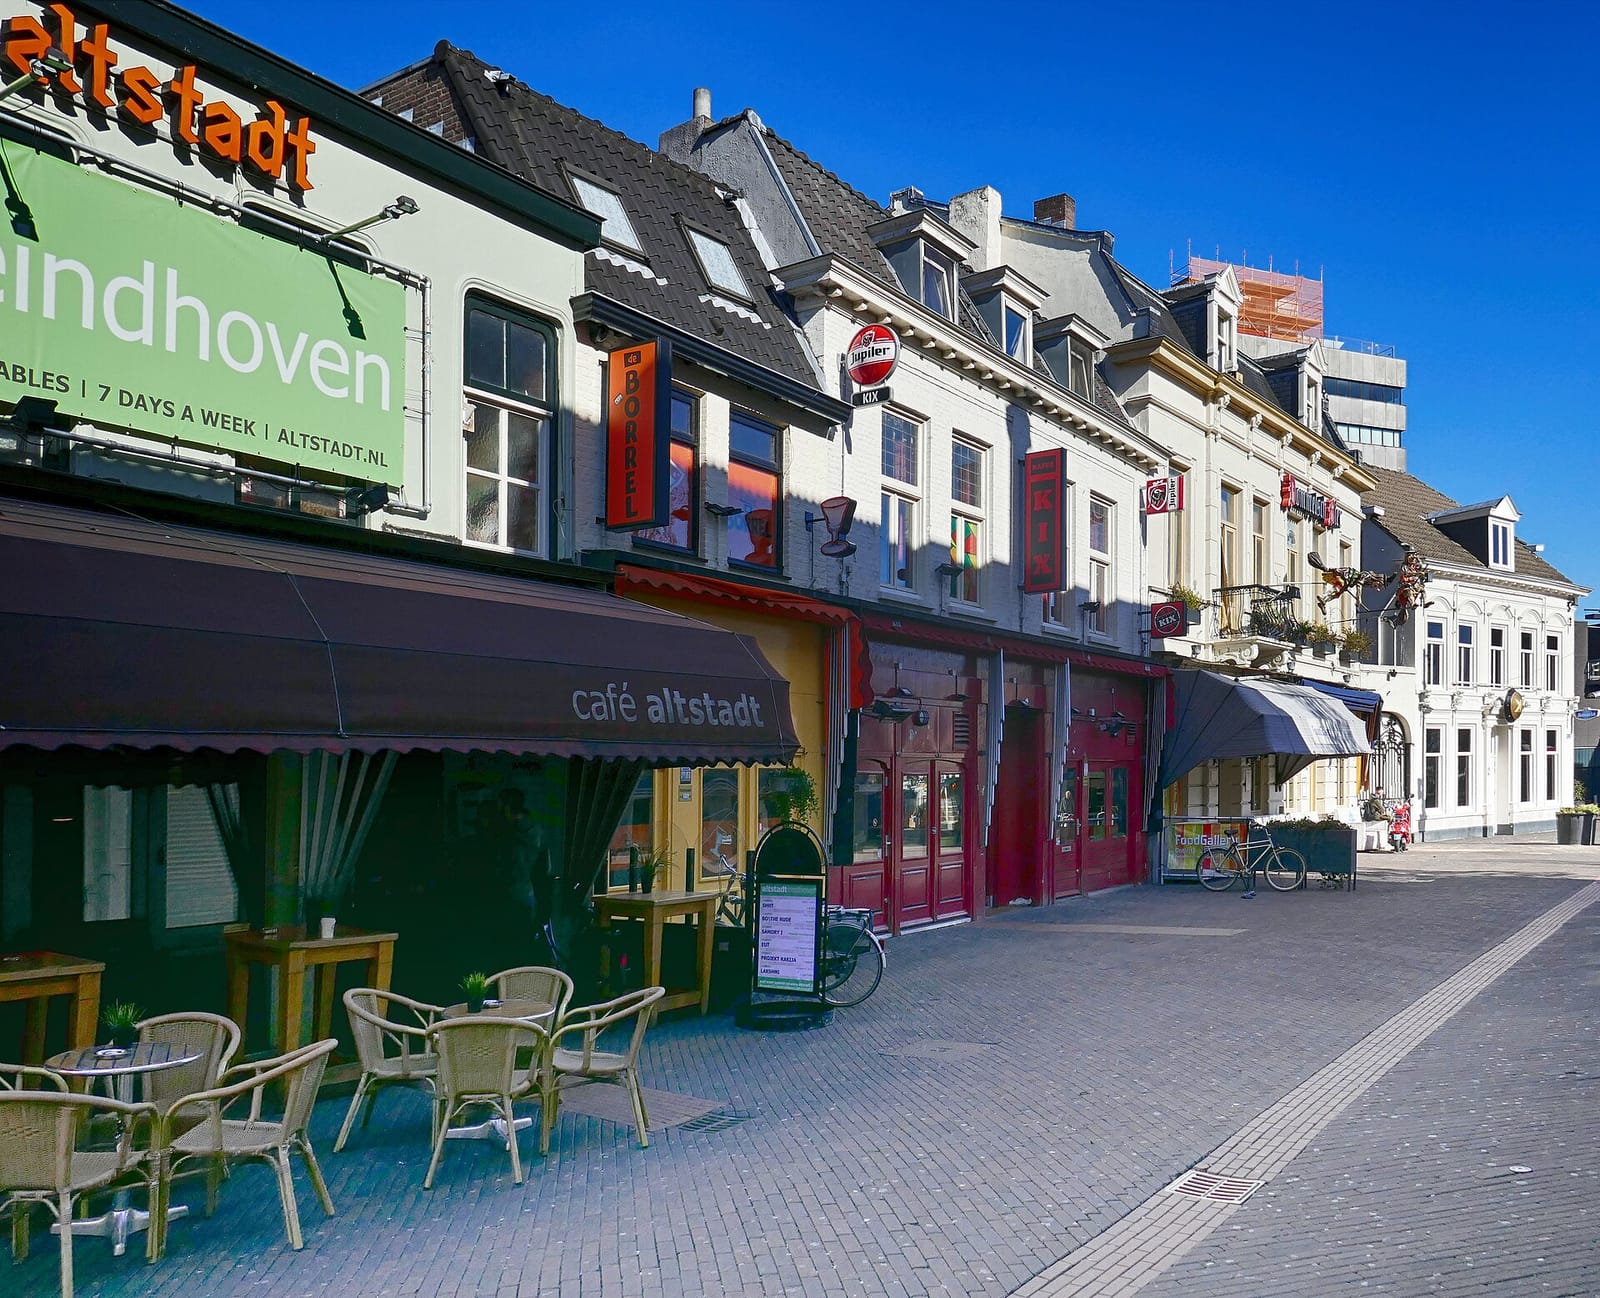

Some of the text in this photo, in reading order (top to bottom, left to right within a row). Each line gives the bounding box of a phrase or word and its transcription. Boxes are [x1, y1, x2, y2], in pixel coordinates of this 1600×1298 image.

[5, 2, 316, 191] altstadt
[0, 222, 391, 412] indhoven
[627, 353, 638, 364] de
[850, 346, 890, 366] Jupiler
[862, 390, 879, 405] KIX
[98, 384, 112, 402] 7
[118, 389, 175, 418] DAYS
[180, 405, 195, 423] A
[200, 408, 256, 437] WEEK
[277, 428, 389, 468] ALTSTADT.NL
[624, 369, 640, 518] BORREL
[1168, 478, 1177, 508] Jupiler
[1033, 489, 1053, 577] KIX
[1158, 614, 1177, 627] KIX
[571, 681, 765, 728] café altstadt
